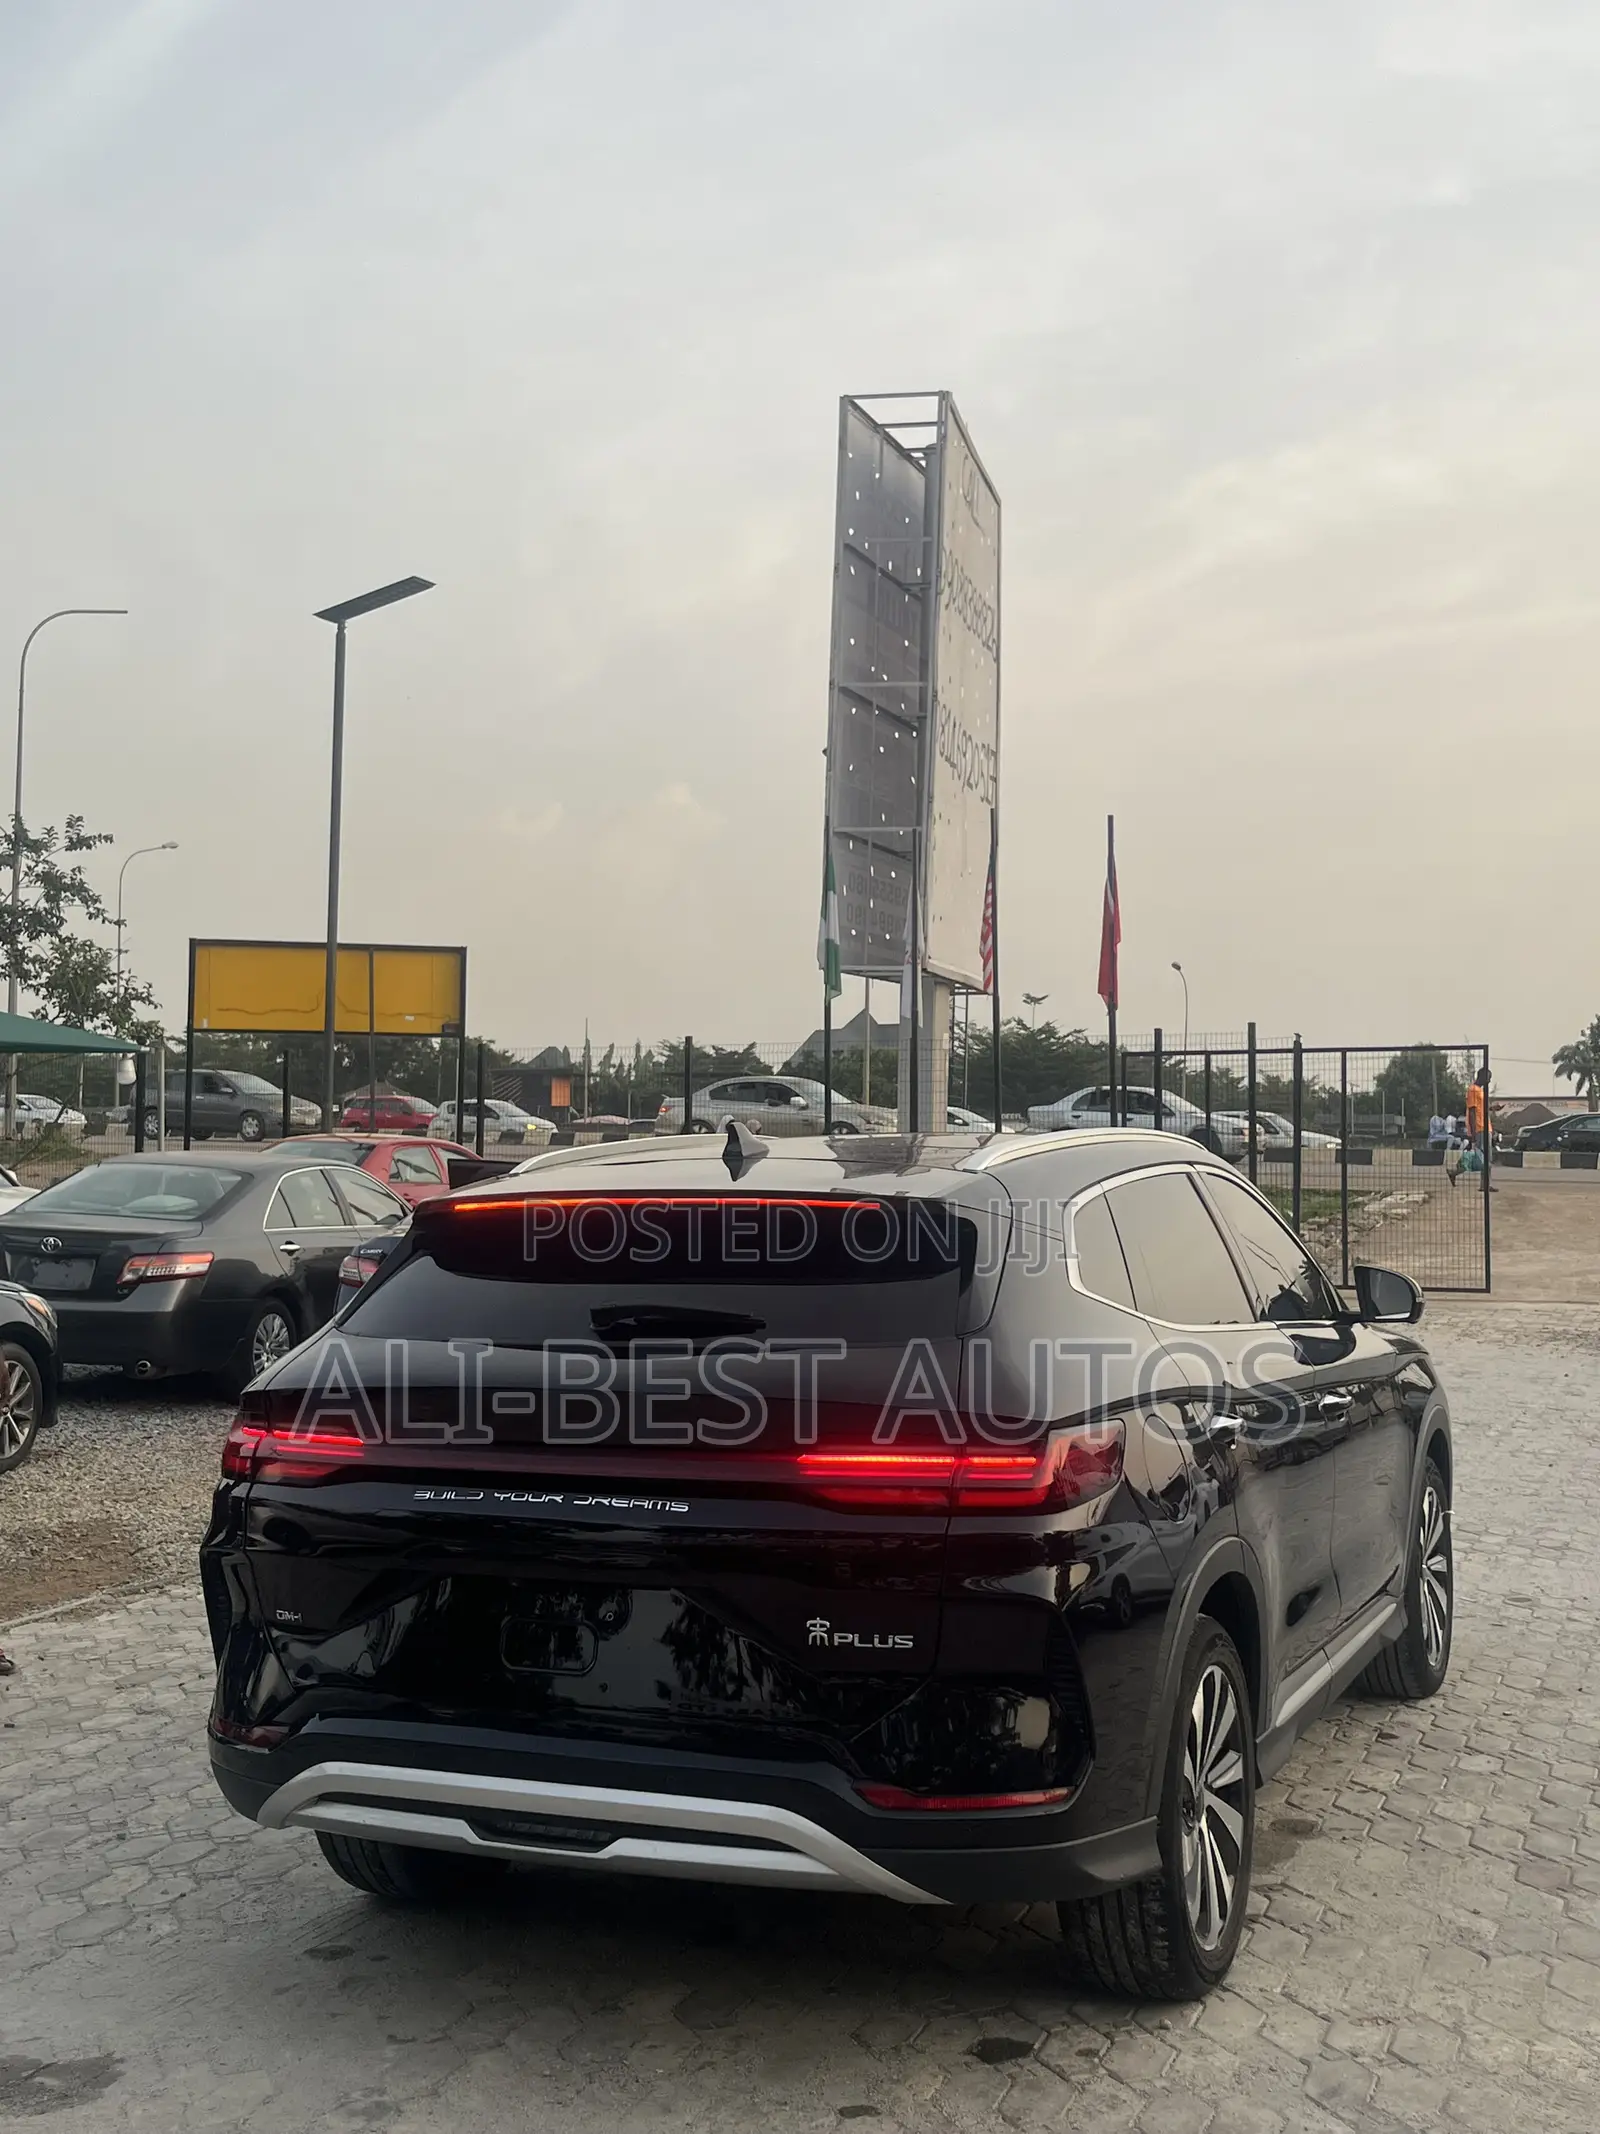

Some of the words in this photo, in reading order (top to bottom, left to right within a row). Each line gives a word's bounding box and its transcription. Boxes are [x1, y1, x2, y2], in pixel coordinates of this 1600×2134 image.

[413, 1489, 484, 1500] BUILD
[494, 1491, 565, 1504] YOUR
[573, 1494, 691, 1513] DREAMS
[833, 1632, 914, 1648] PLUS
